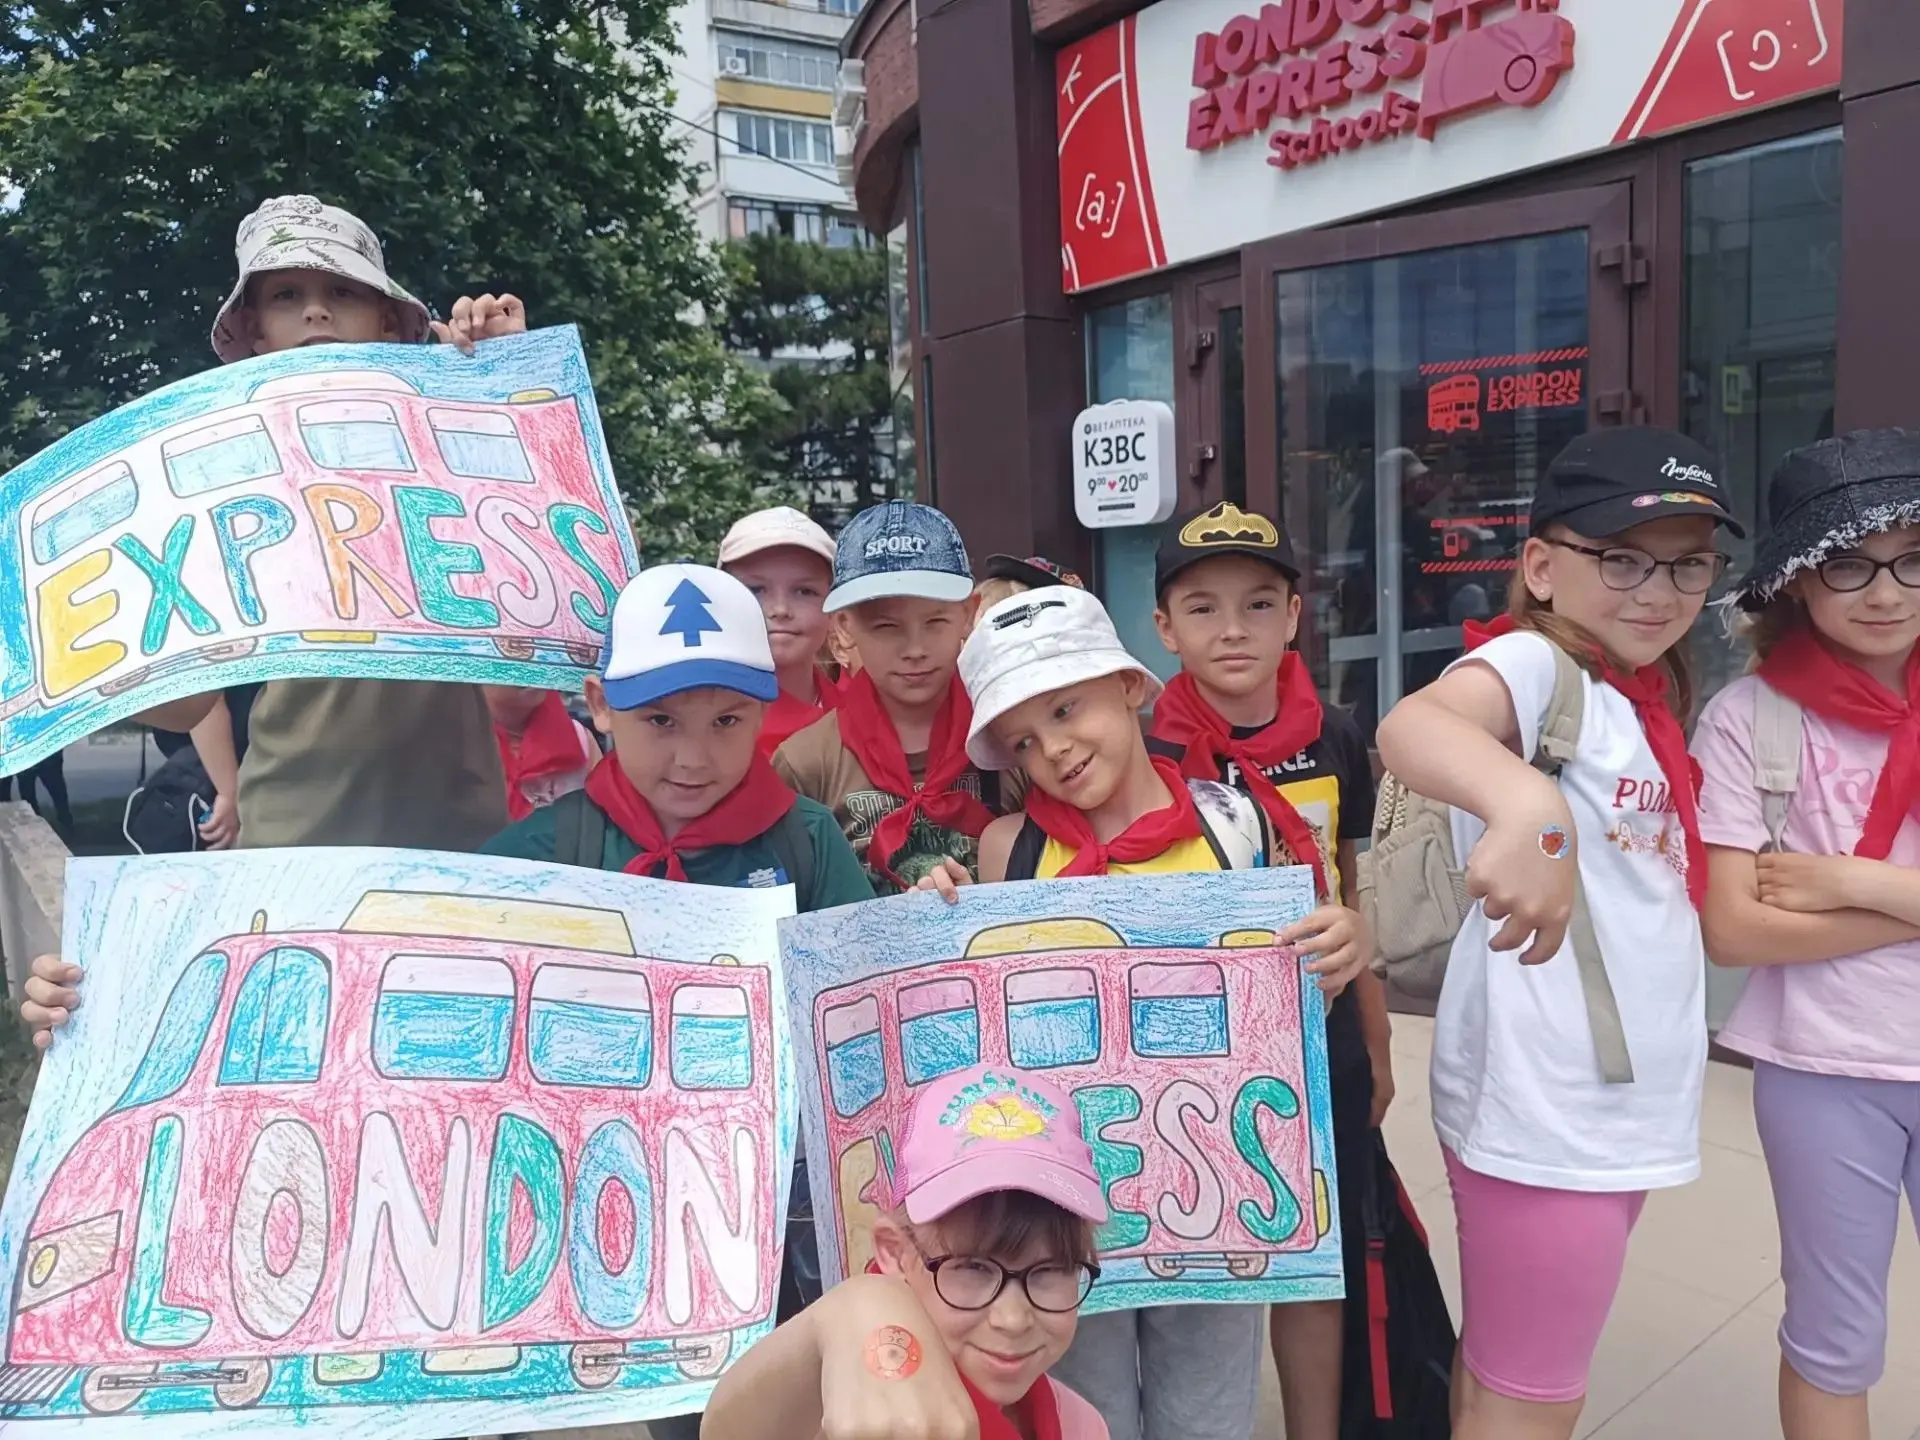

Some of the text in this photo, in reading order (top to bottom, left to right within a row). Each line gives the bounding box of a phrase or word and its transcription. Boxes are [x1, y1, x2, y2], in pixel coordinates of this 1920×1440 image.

[1187, 15, 1430, 150] EXPRESS
[1192, 0, 1411, 88] LOND
[1267, 91, 1420, 170] Schools
[1487, 387, 1580, 412] EXPRESS
[1488, 368, 1581, 393] LONDON
[865, 535, 927, 560] SPORT
[36, 484, 619, 699] EXPRESS
[121, 1110, 763, 1350] LONDON
